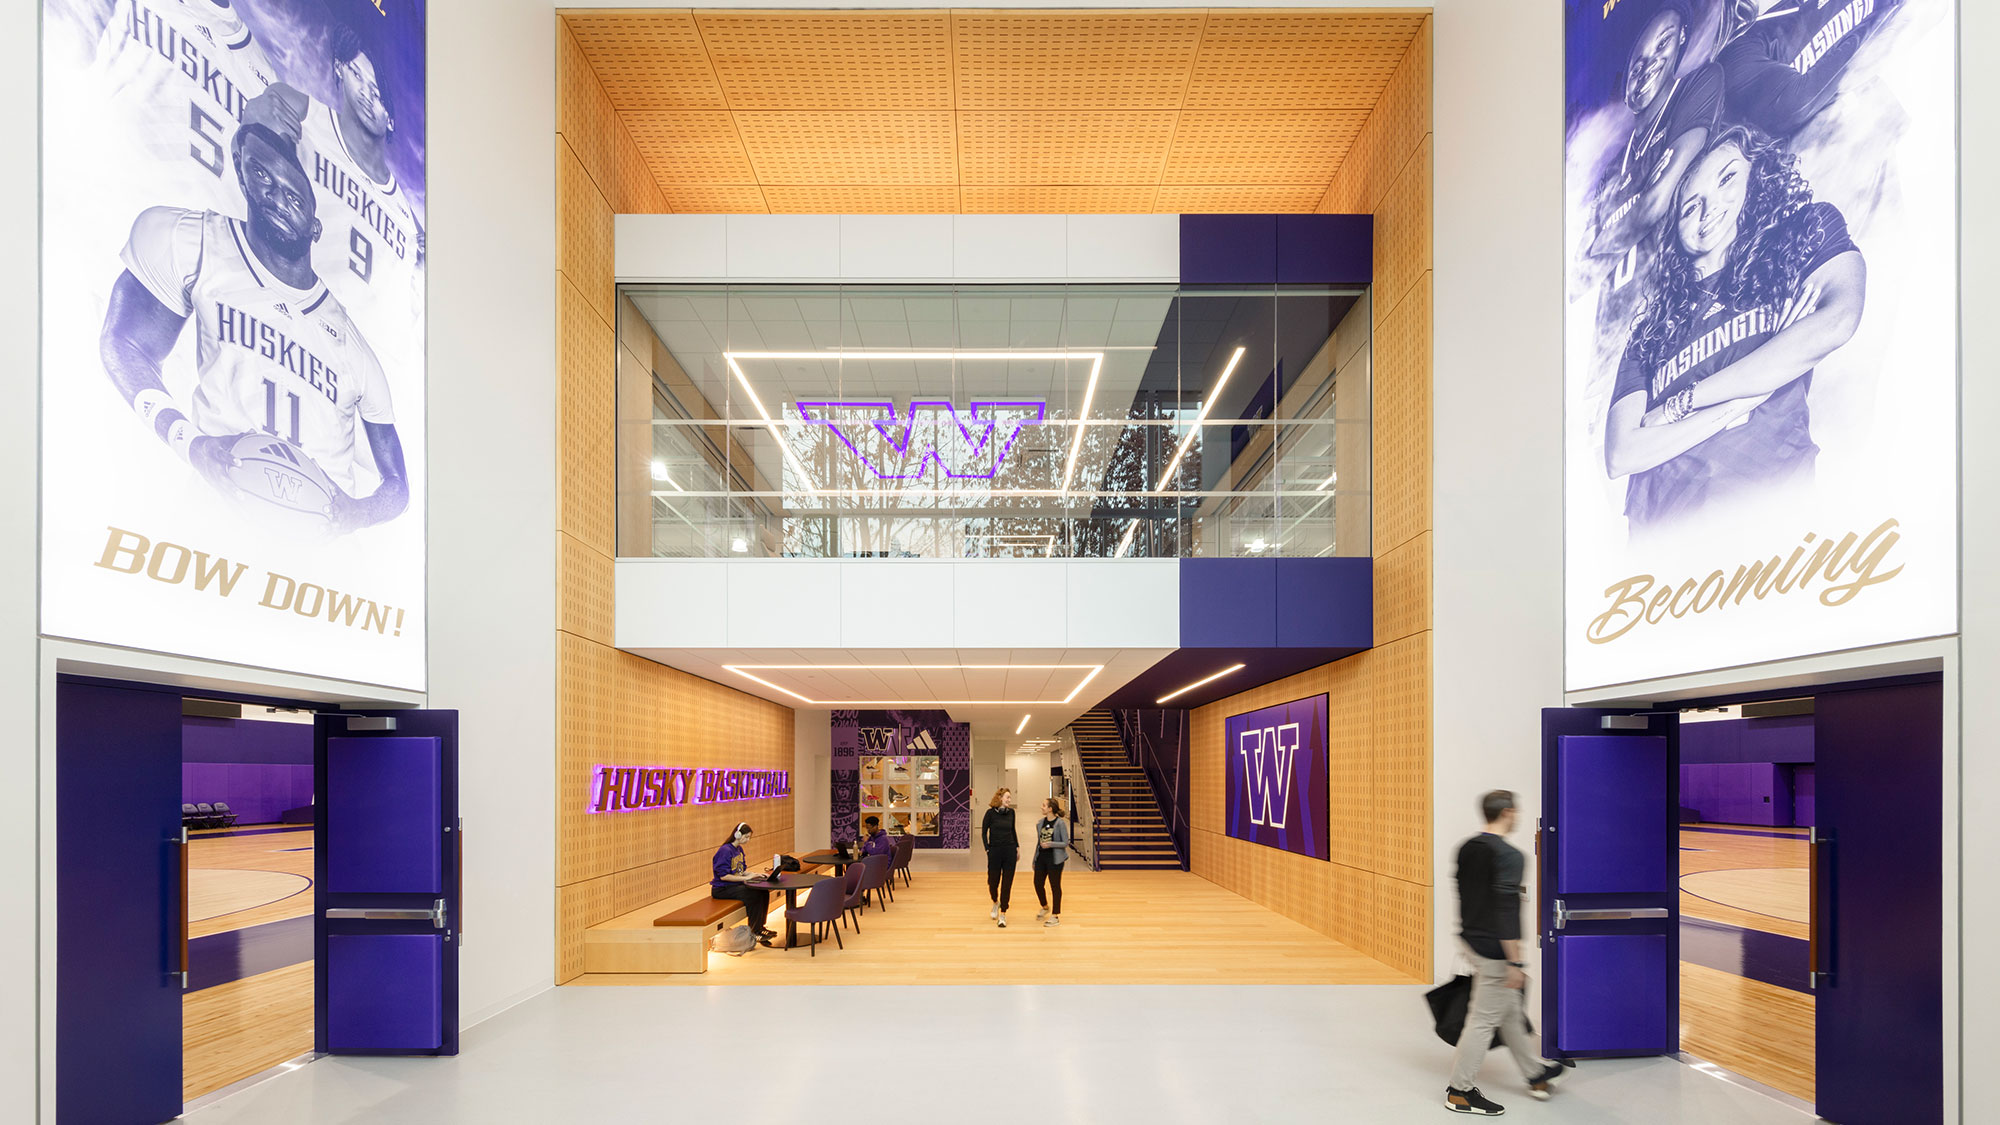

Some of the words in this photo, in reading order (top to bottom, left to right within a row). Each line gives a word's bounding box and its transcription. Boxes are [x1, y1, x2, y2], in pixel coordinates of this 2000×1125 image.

[130, 0, 249, 123] HUSKI
[190, 98, 225, 178] 5
[314, 150, 406, 260] HUSKIES
[349, 226, 373, 284] 9
[216, 302, 339, 405] HUSKIES
[262, 376, 304, 448] 11
[796, 401, 1046, 479] W
[264, 467, 303, 503] W
[94, 526, 249, 598] BOW
[258, 571, 405, 637] DOWN!
[1586, 517, 1906, 645] Becoming
[833, 747, 855, 757] 1896
[860, 727, 894, 751] W
[1240, 722, 1299, 829] W
[594, 767, 696, 812] HUSKY
[697, 769, 791, 803] BASKETBALL
